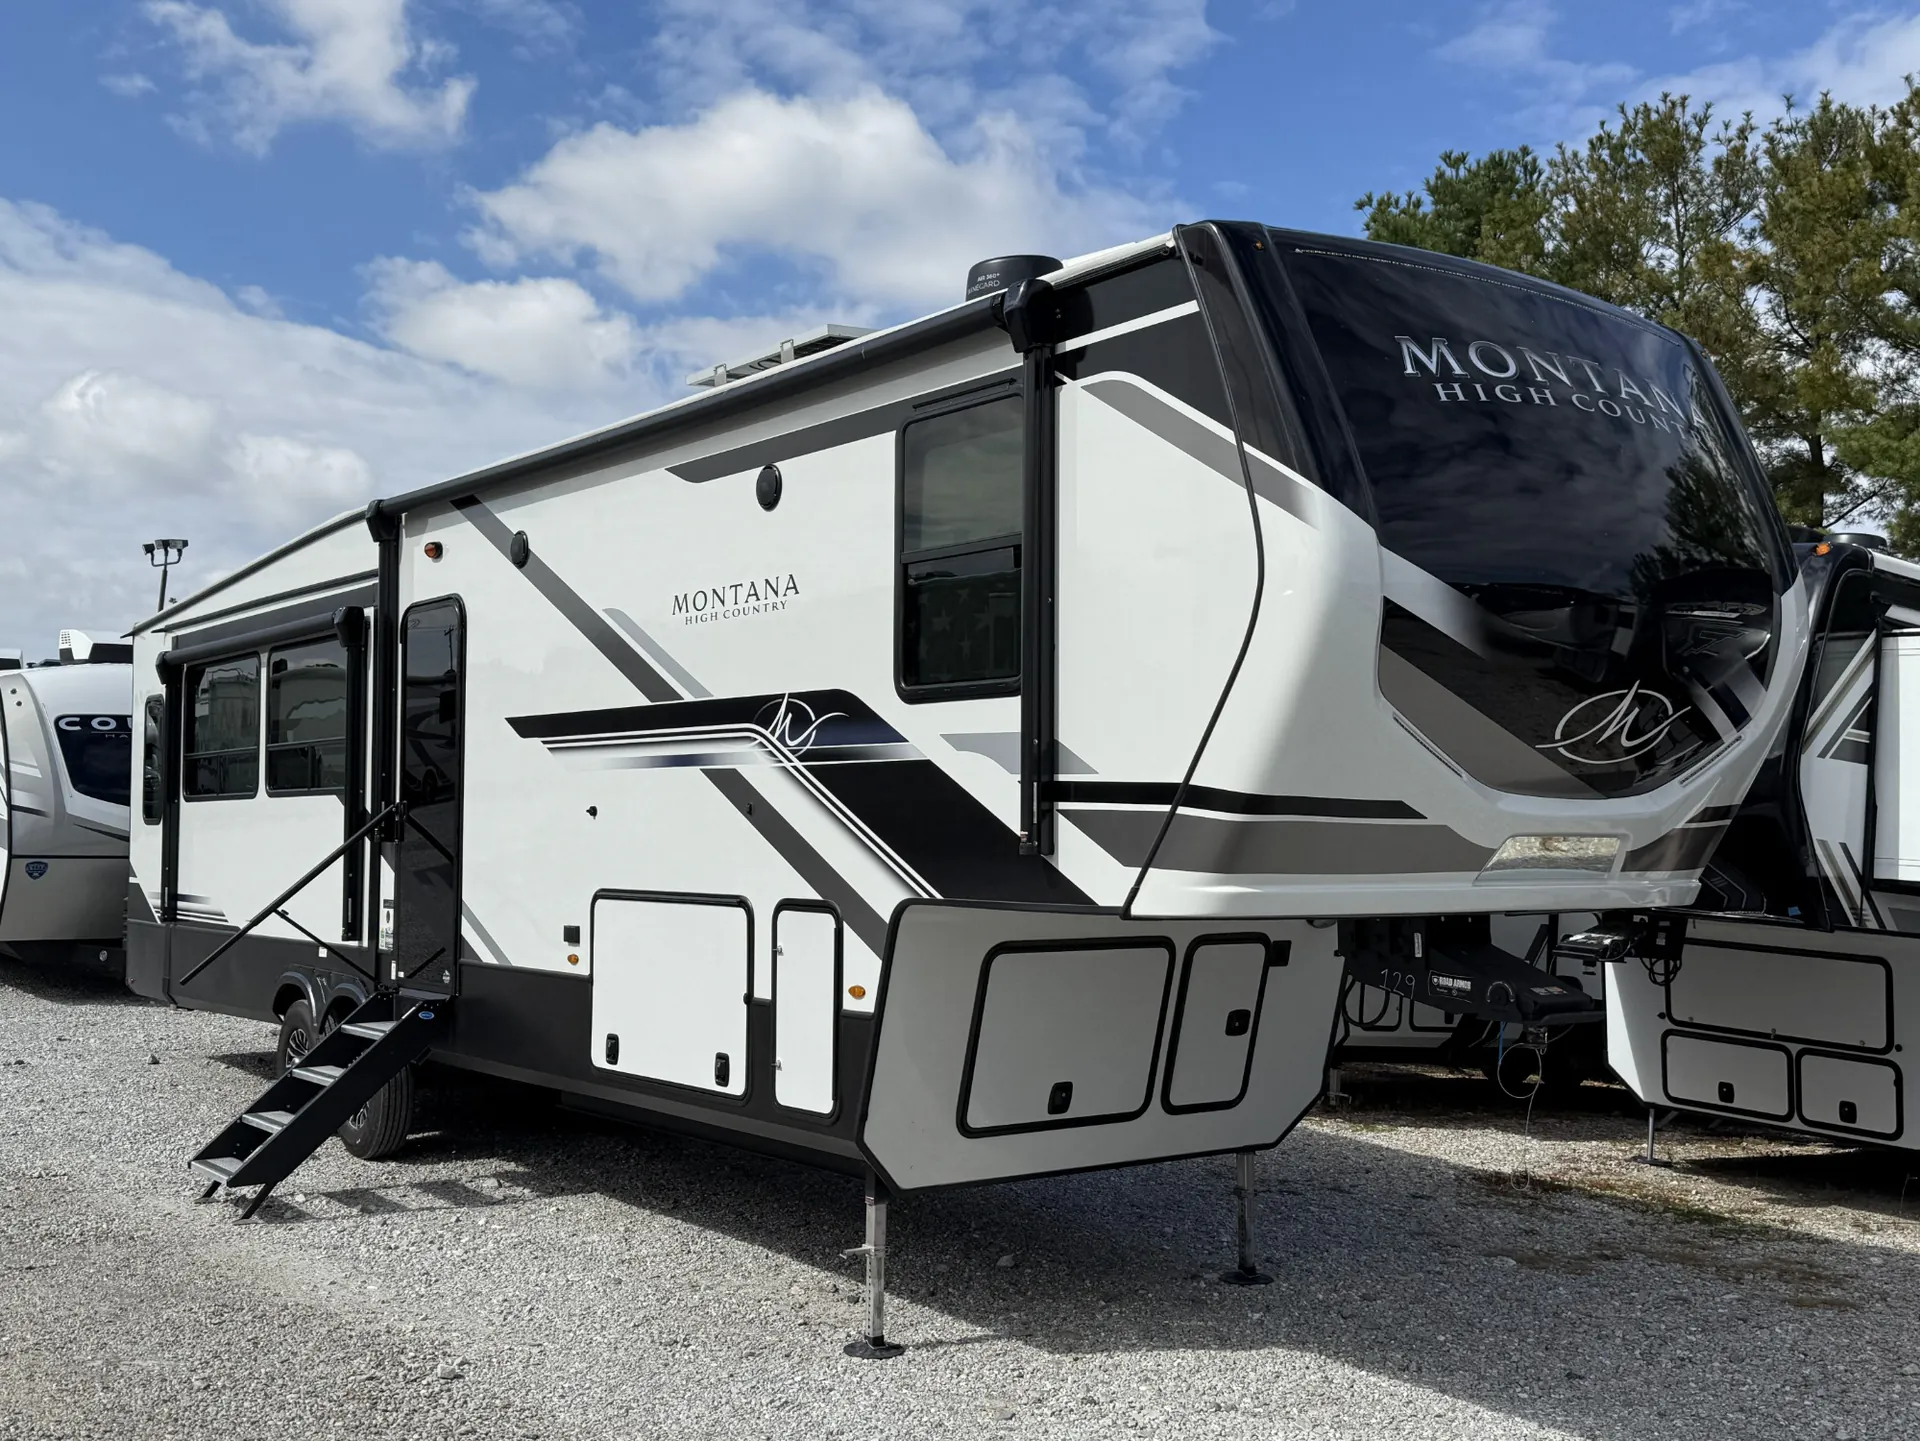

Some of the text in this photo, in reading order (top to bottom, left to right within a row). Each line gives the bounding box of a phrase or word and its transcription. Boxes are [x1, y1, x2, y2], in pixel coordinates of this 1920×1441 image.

[1395, 335, 1712, 436] MONTANA
[1433, 382, 1712, 454] HIGH COUNTR
[672, 574, 800, 616] MONTANA
[685, 600, 788, 625] HIGH COUNTRY
[58, 716, 133, 731] CO
[1380, 969, 1415, 1000] 129
